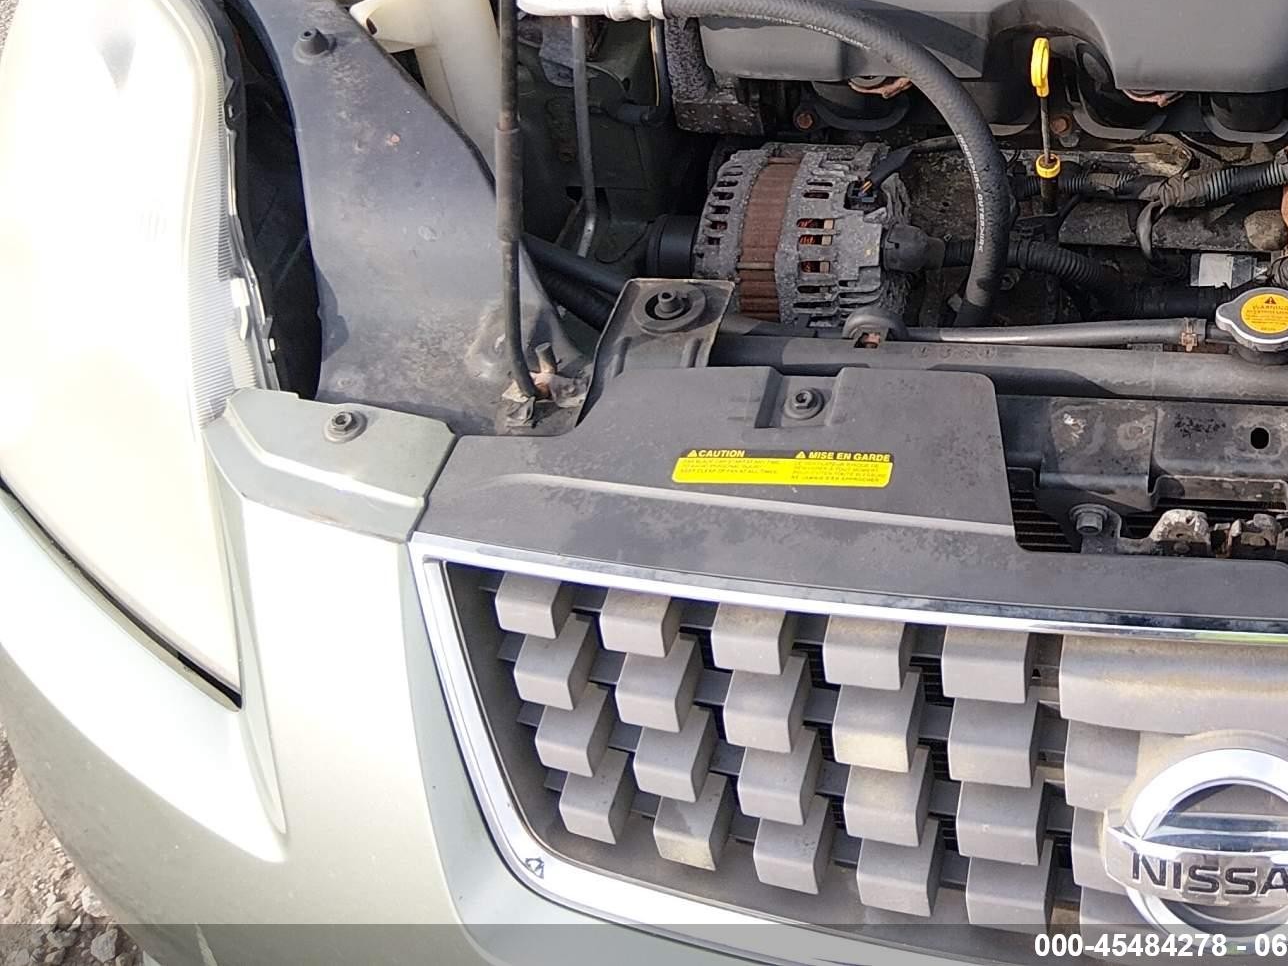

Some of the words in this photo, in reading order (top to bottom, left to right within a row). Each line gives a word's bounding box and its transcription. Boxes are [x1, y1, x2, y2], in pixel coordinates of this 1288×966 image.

[698, 449, 745, 459] CAUTION
[808, 451, 835, 460] MISE
[836, 452, 851, 461] EN
[852, 453, 890, 462] GARDE
